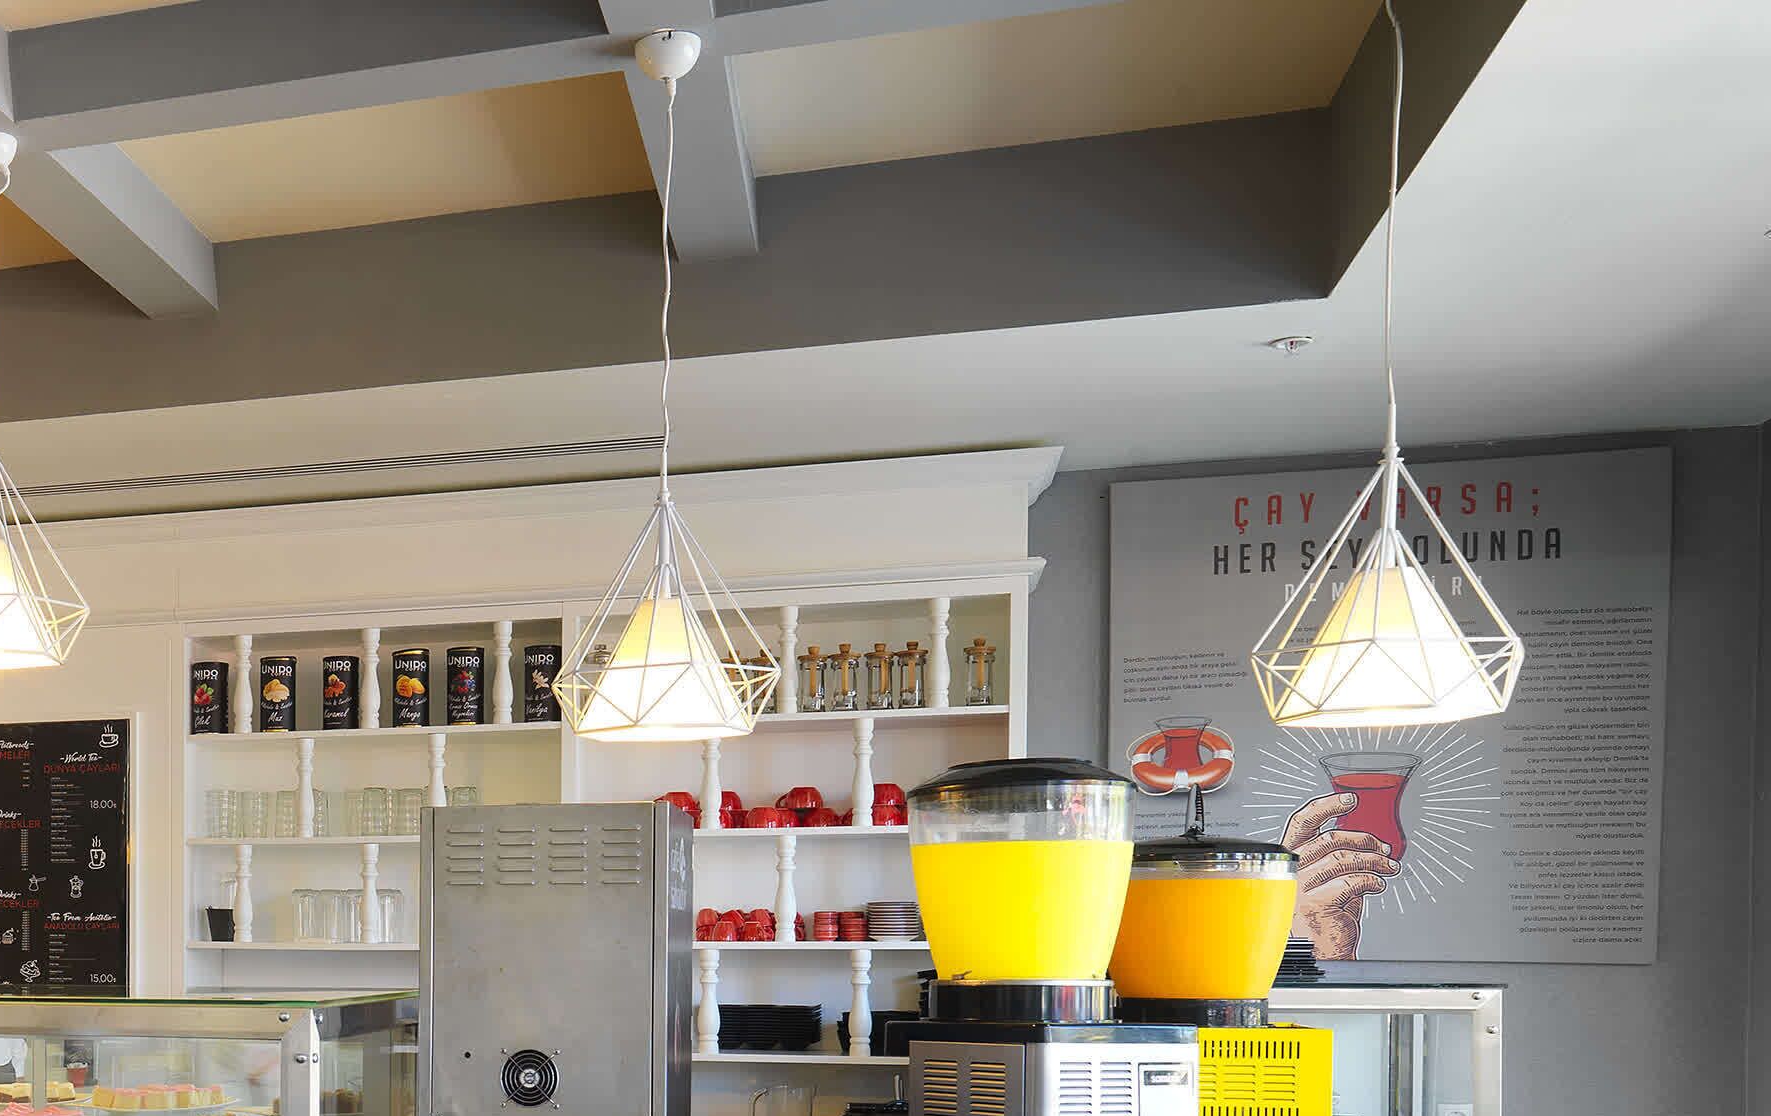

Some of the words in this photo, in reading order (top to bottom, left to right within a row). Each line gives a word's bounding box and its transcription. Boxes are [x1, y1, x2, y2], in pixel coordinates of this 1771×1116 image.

[1234, 492, 1315, 535] ÇAY
[1355, 481, 1541, 521] VARSA;
[1212, 541, 1276, 576] HER
[1394, 527, 1562, 567] OLUNDA
[394, 660, 427, 670] UNIDO
[447, 655, 480, 666] UNIDO
[261, 664, 293, 675] UNIDO
